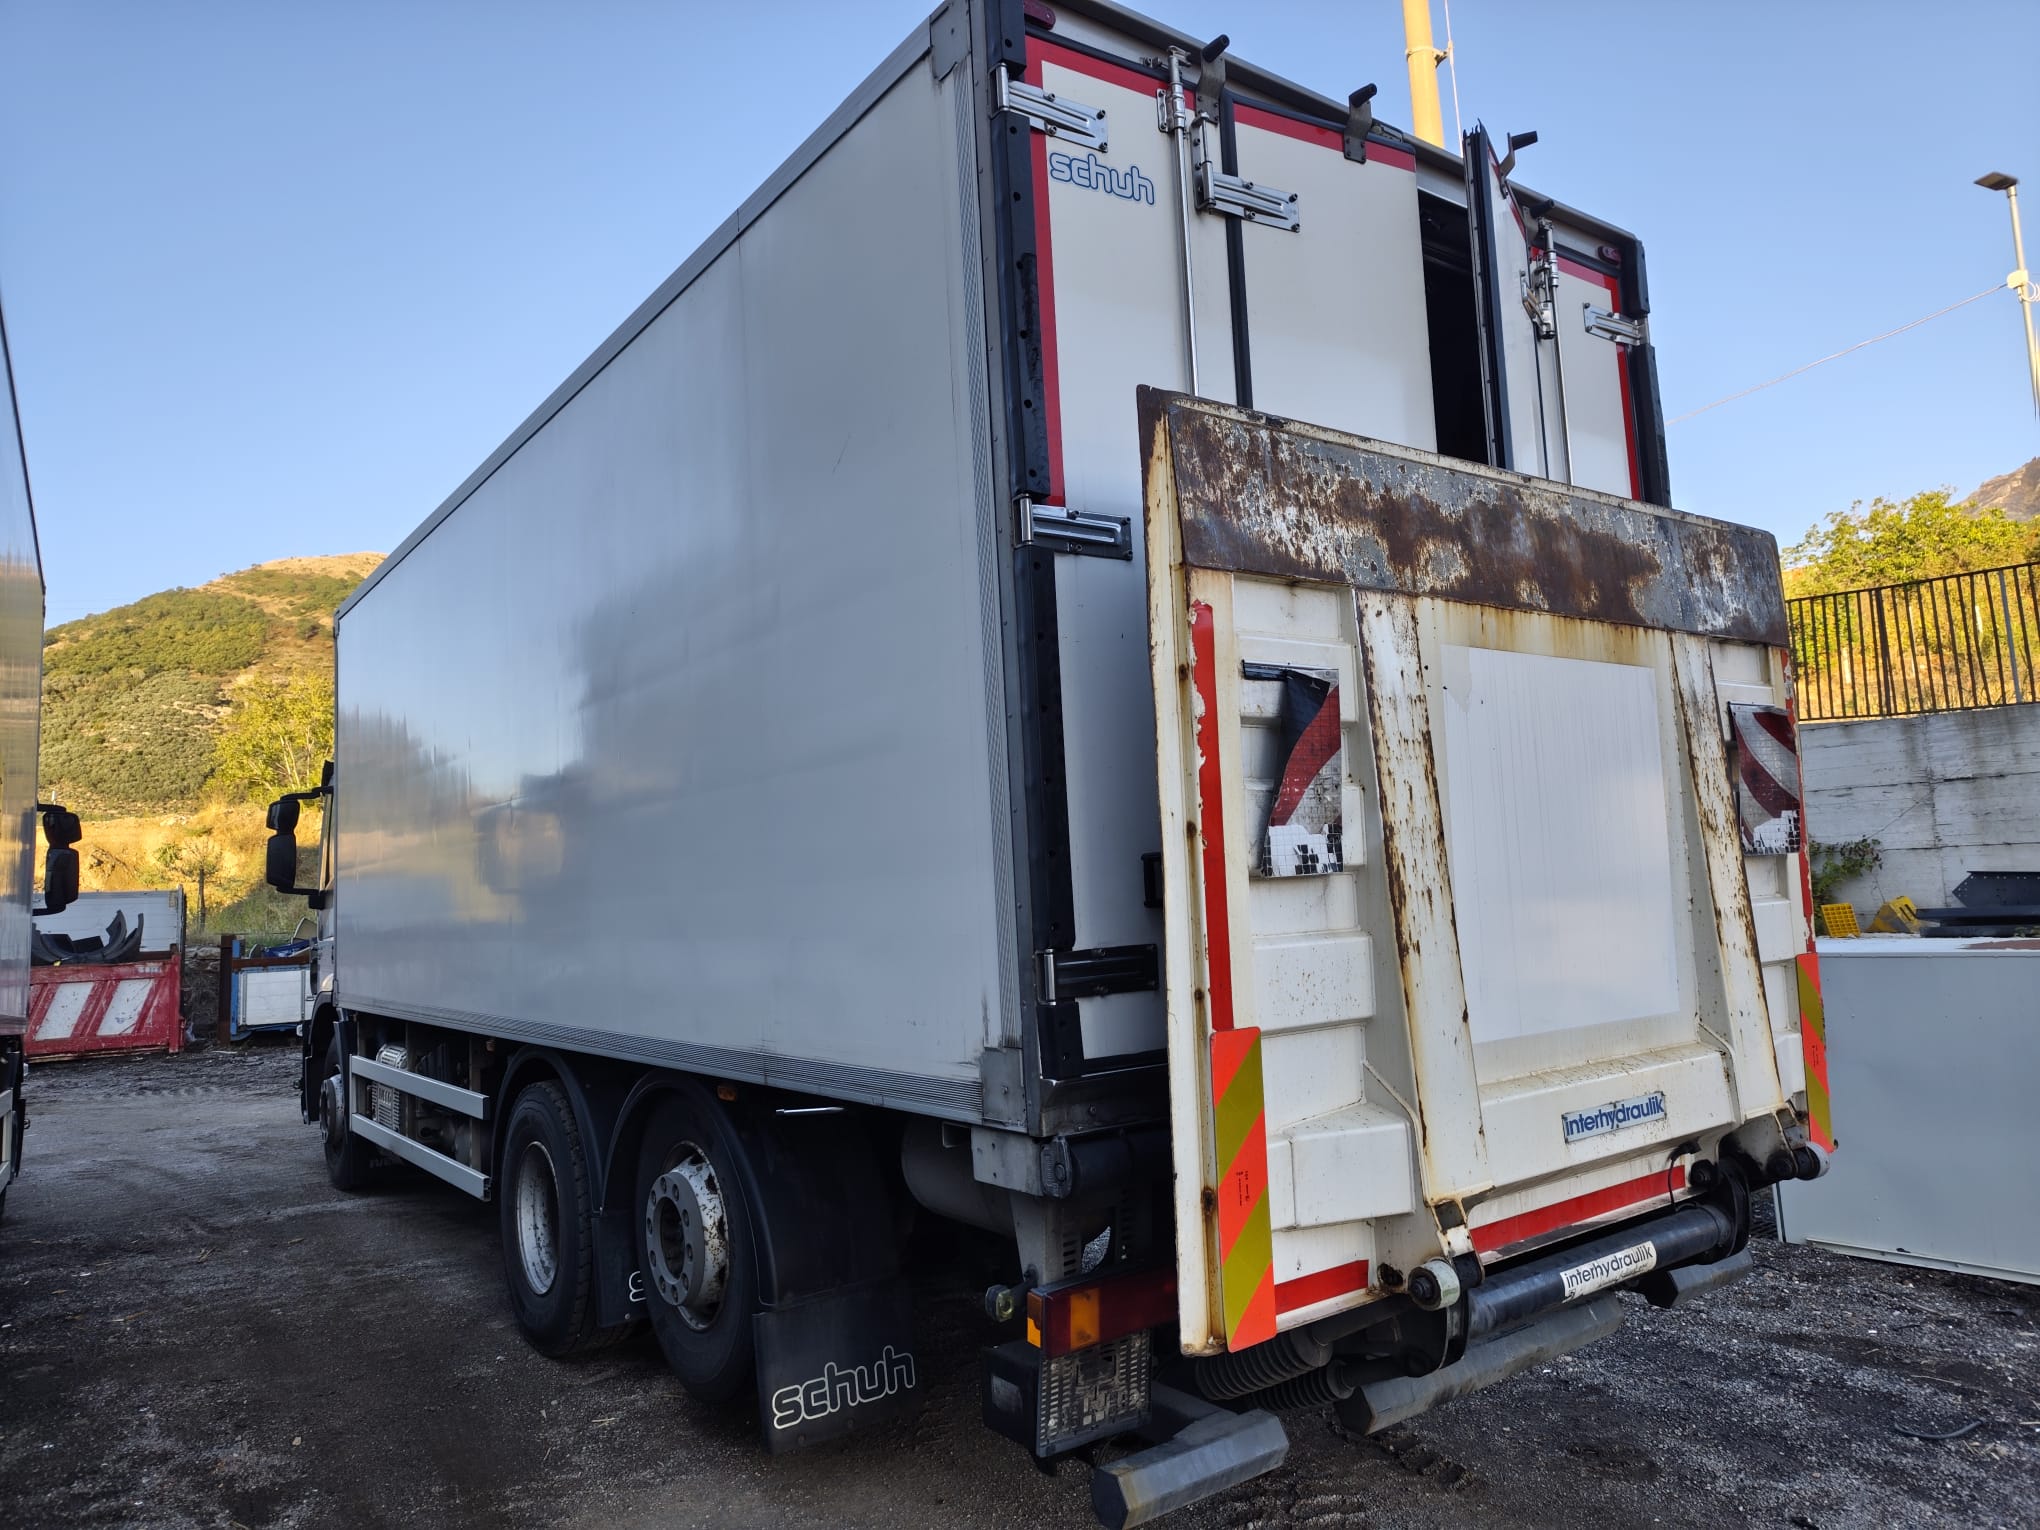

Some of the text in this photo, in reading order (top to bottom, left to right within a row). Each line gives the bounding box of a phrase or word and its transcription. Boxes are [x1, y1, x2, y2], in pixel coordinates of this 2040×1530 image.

[1050, 153, 1155, 205] schuh
[1565, 1096, 1665, 1136] interhydraulik
[1564, 1246, 1654, 1288] interhydraulik
[772, 1345, 915, 1429] schuh
